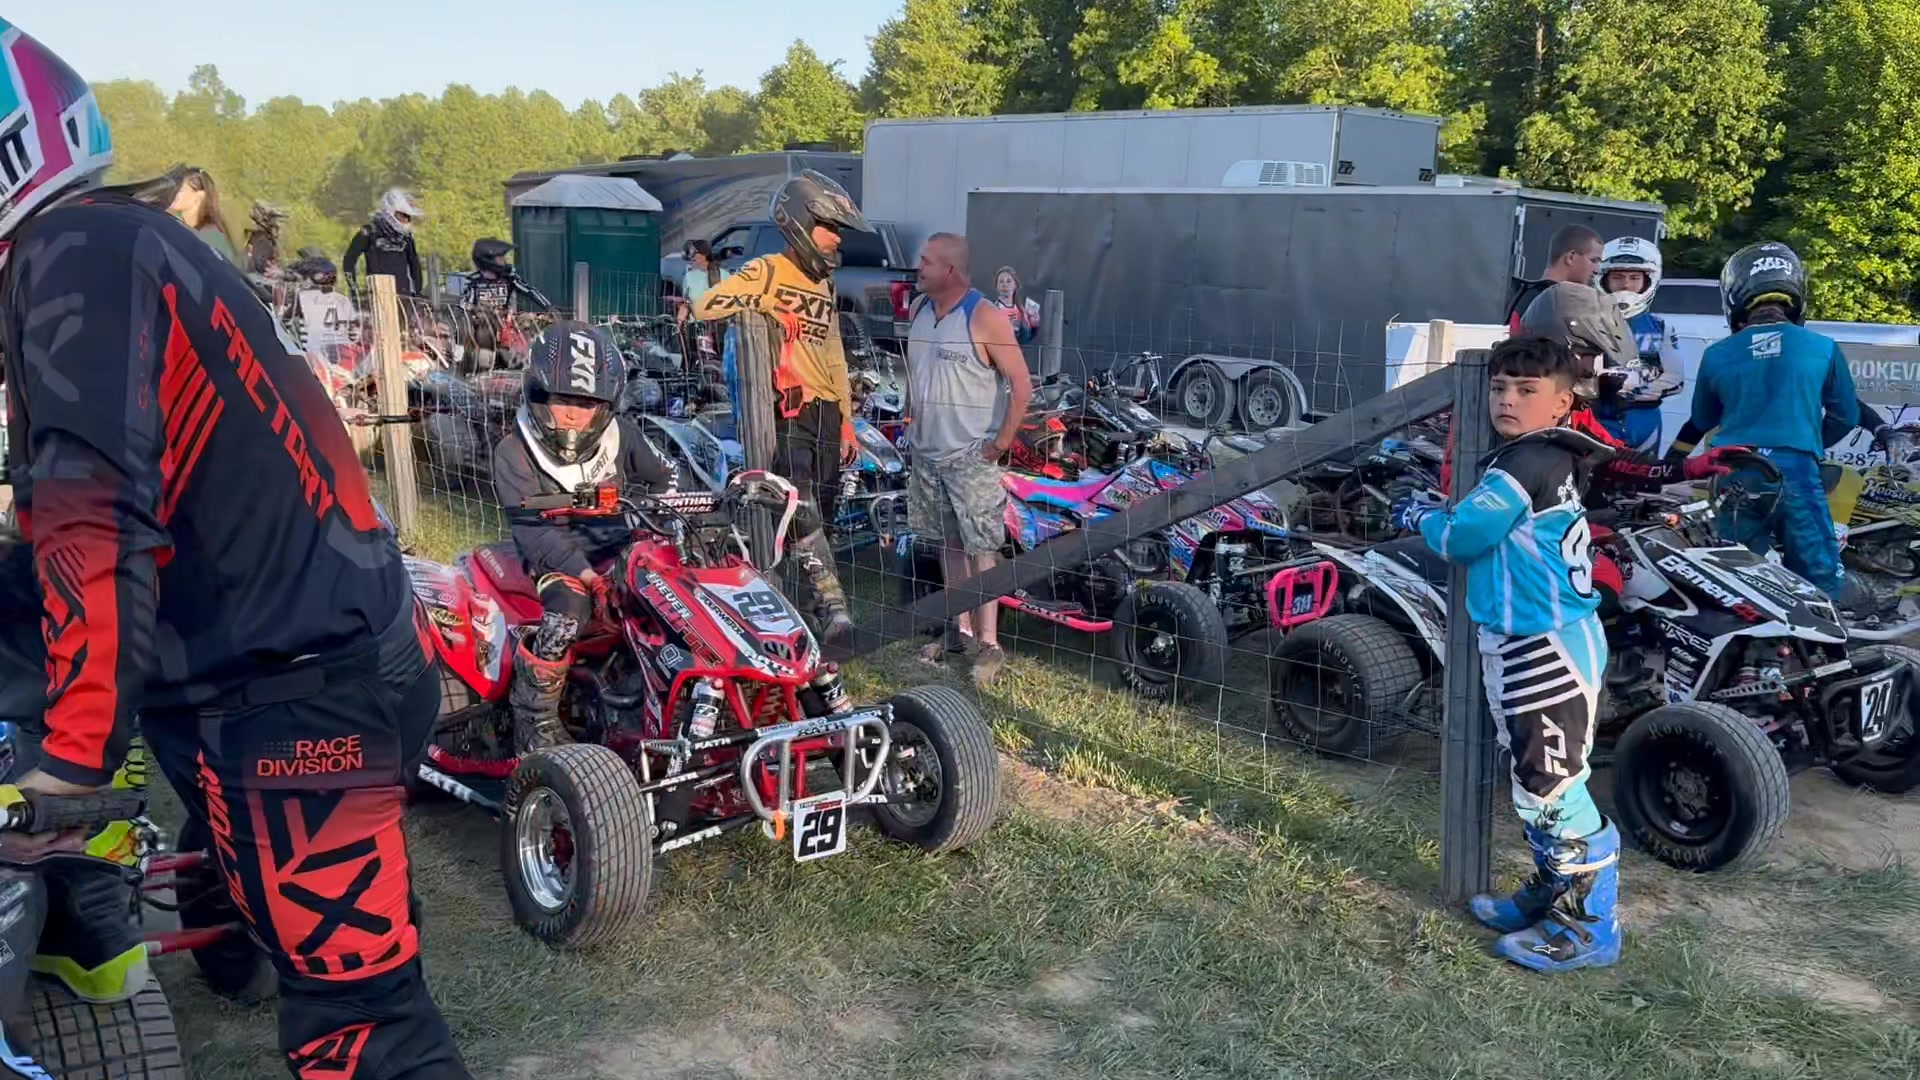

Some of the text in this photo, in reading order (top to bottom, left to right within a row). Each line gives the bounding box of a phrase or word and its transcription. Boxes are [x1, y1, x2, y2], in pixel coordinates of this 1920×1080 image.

[569, 332, 596, 394] FXR
[210, 295, 333, 521] FACTORY
[732, 591, 785, 619] 29
[1656, 555, 1744, 607] Element
[257, 753, 363, 777] DIVISION
[295, 734, 362, 758] RACE
[1541, 713, 1570, 777] FLY
[798, 806, 843, 858] 29
